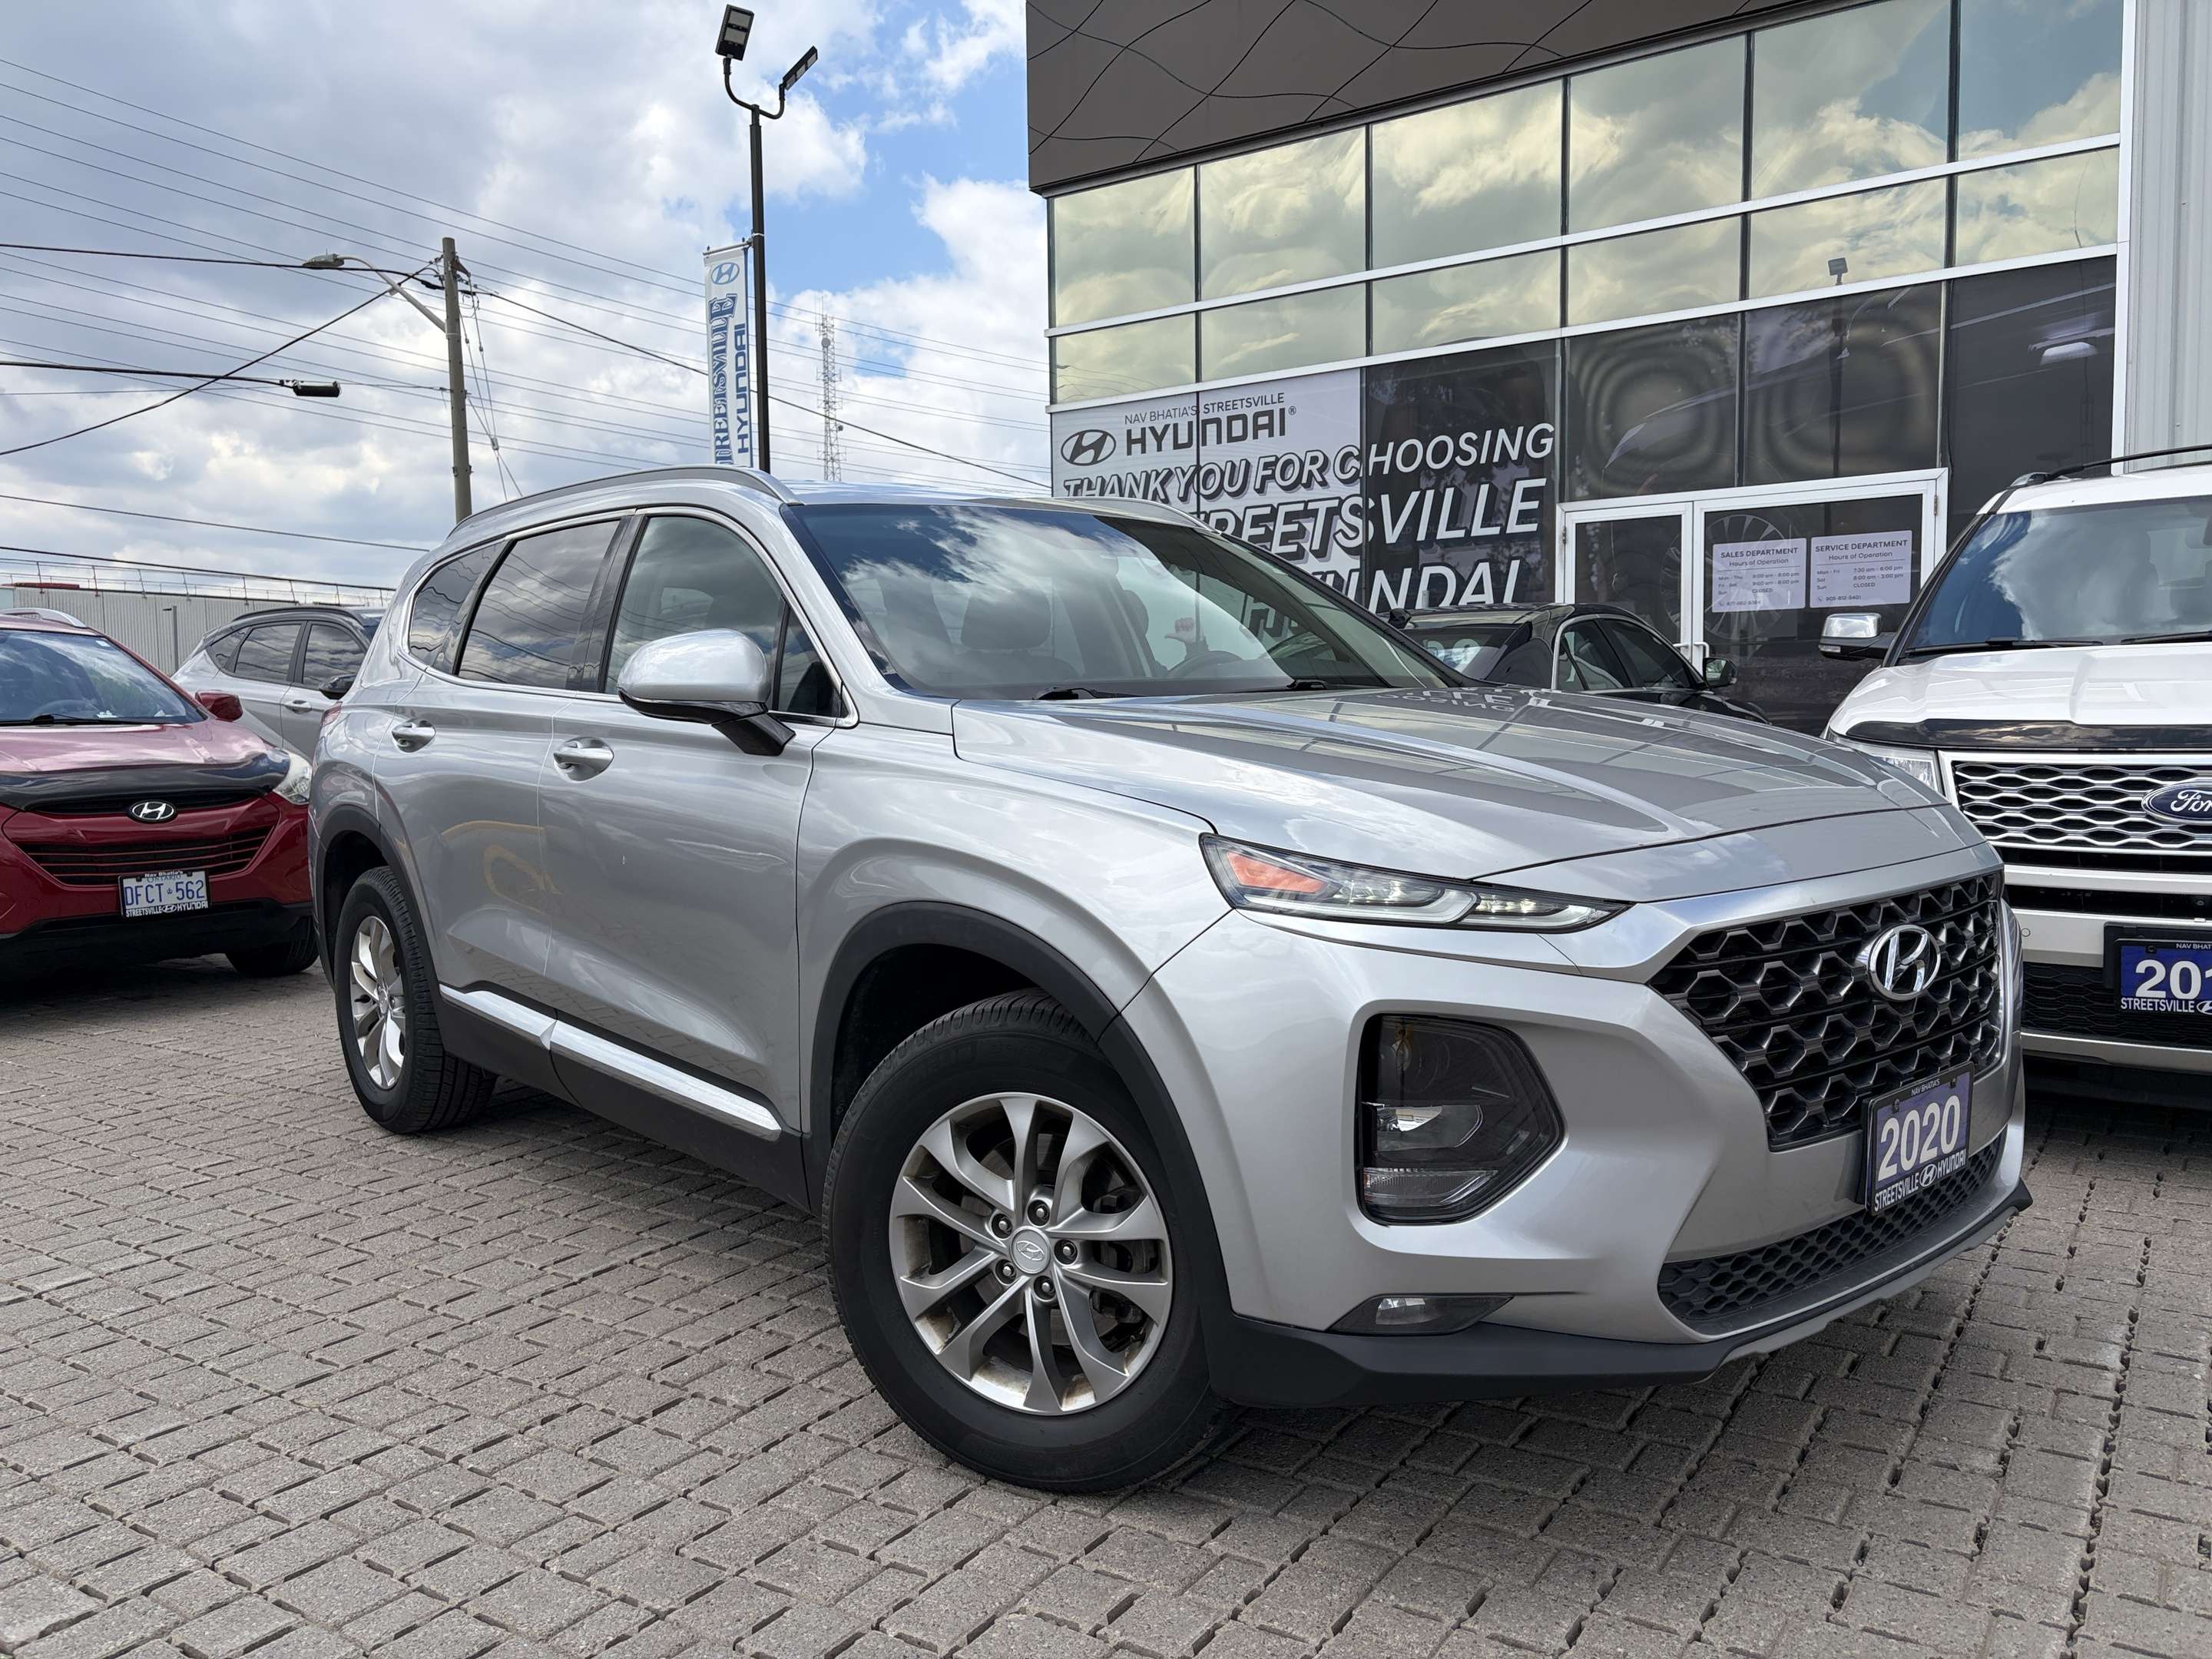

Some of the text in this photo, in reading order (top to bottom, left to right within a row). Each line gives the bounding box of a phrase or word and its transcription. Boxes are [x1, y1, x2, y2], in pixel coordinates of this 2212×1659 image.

[733, 323, 749, 454] HYUNDAI
[1124, 414, 1146, 425] NAV
[1203, 392, 1285, 415] STREETSVILLE
[1064, 422, 1555, 503] THANK YOU FOR CHOOSING
[1746, 547, 1799, 557] DEPARTMENT
[1815, 539, 1908, 552] SERVICE DEPARTMENT
[124, 879, 205, 906] DFCT 562
[126, 901, 209, 918] STREETSVILLE HYUNDAI
[2121, 997, 2195, 1013] STREETSVILLE
[1911, 1085, 1922, 1097] NAV
[1878, 1095, 1961, 1181] 2020
[1874, 1149, 1966, 1212] STREETSVILLE HYUNDAI
